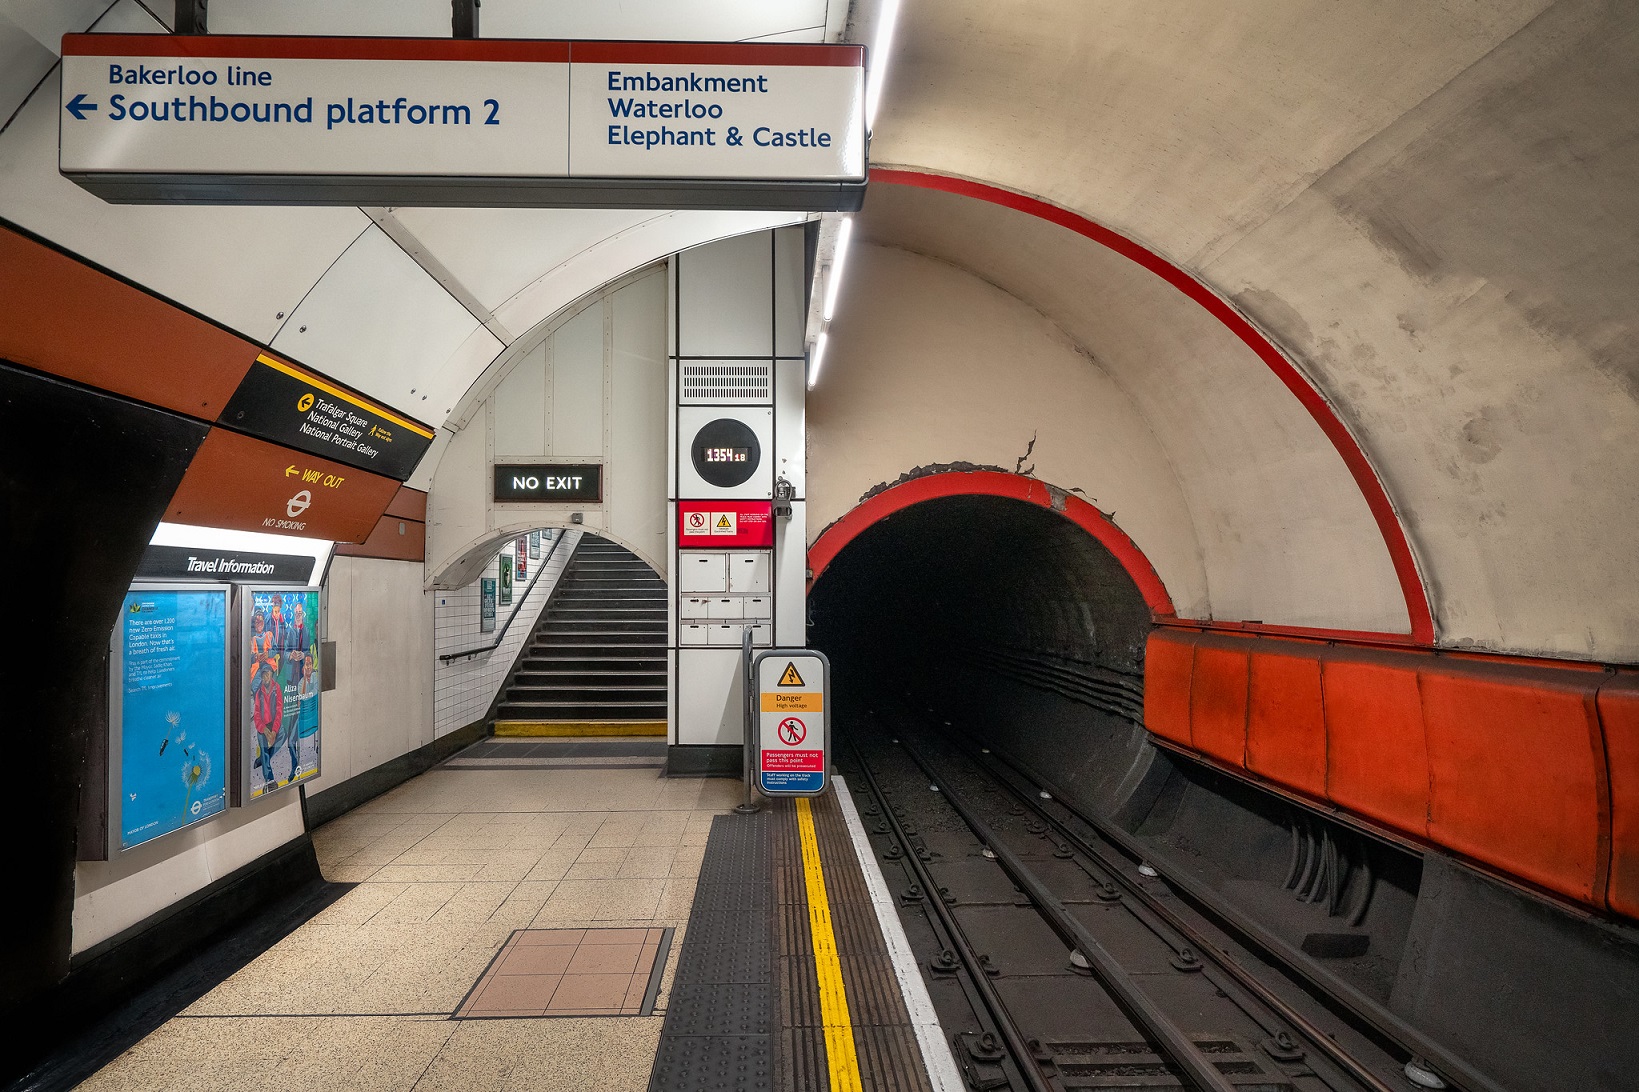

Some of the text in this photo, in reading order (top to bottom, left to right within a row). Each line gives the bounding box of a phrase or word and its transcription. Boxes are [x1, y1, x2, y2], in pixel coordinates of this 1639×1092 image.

[109, 64, 272, 86] Bakerloo line
[608, 71, 768, 92] Embankment
[108, 94, 500, 130] Southbound platform 2
[608, 98, 723, 119] Waterloo
[608, 125, 832, 150] Elephant & Castle
[316, 398, 368, 428] Trafalgar Square
[307, 410, 363, 440] National Gallery
[300, 422, 379, 459] National Portrait Gallery
[706, 448, 746, 462] 1354 18
[302, 468, 345, 489] WAY OUT
[513, 476, 583, 489] NO EXIT
[262, 518, 306, 531] NO SMOKING
[187, 556, 275, 575] Travel Information
[284, 685, 297, 693] Aliza
[284, 692, 314, 704] Nisenbaum
